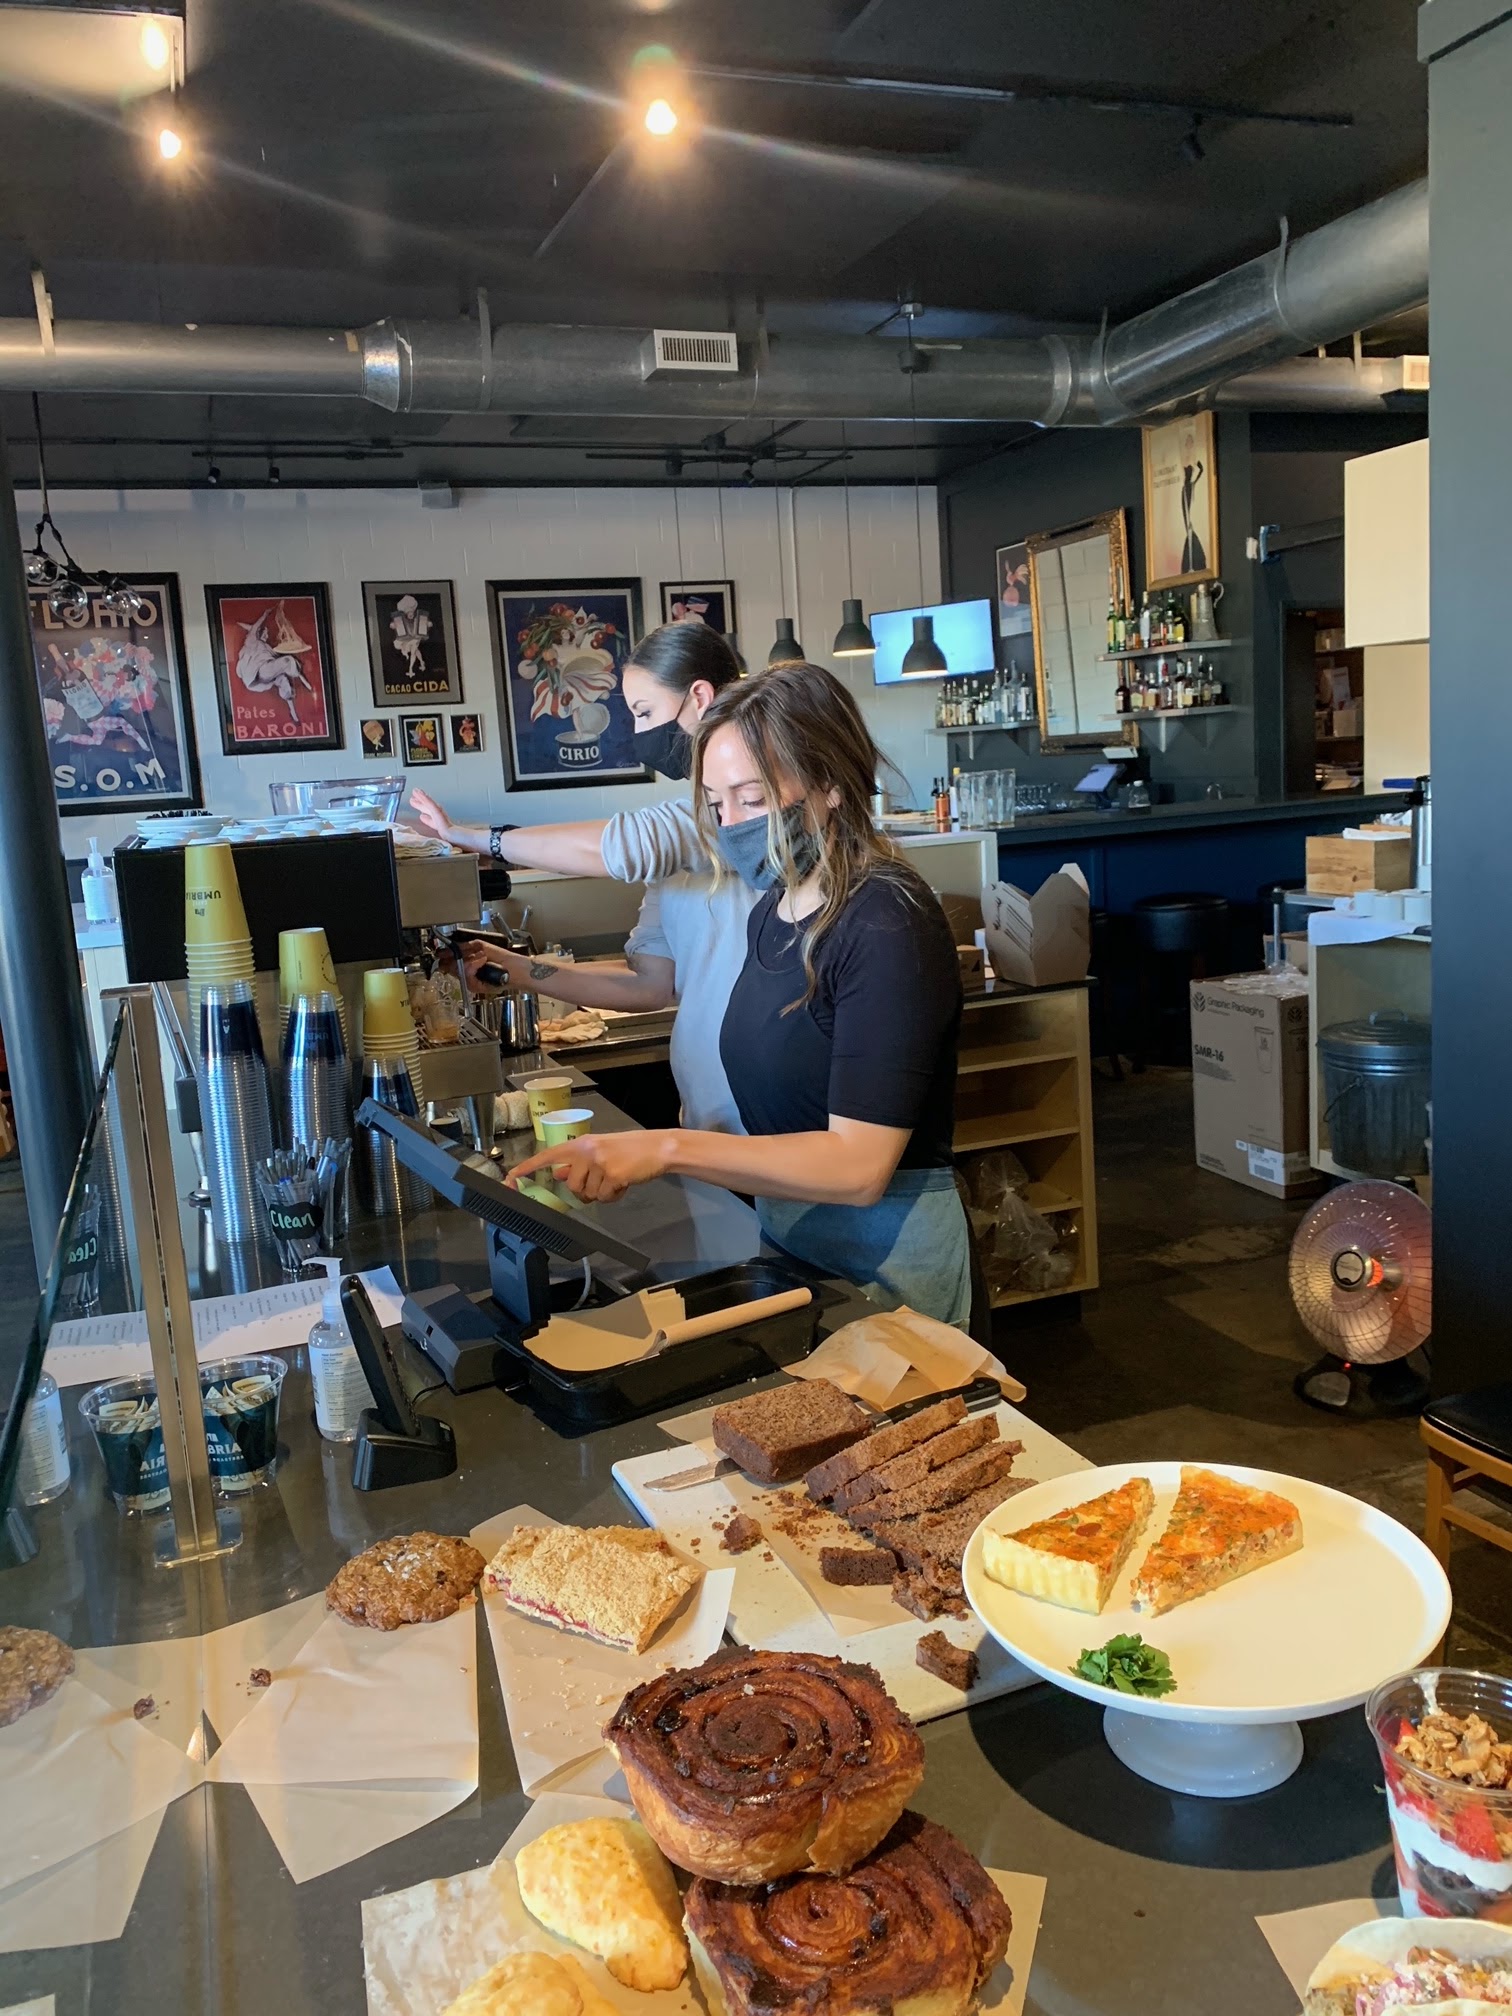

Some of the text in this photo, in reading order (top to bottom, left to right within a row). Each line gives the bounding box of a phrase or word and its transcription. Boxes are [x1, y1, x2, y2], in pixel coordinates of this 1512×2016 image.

[30, 598, 158, 630] LORIO
[385, 680, 449, 694] CACAO CIDA
[236, 722, 324, 739] BARONI
[559, 745, 600, 761] CIRIO
[1194, 1044, 1225, 1062] SMR-16
[270, 1209, 316, 1229] Clean
[207, 1442, 243, 1455] BRIA
